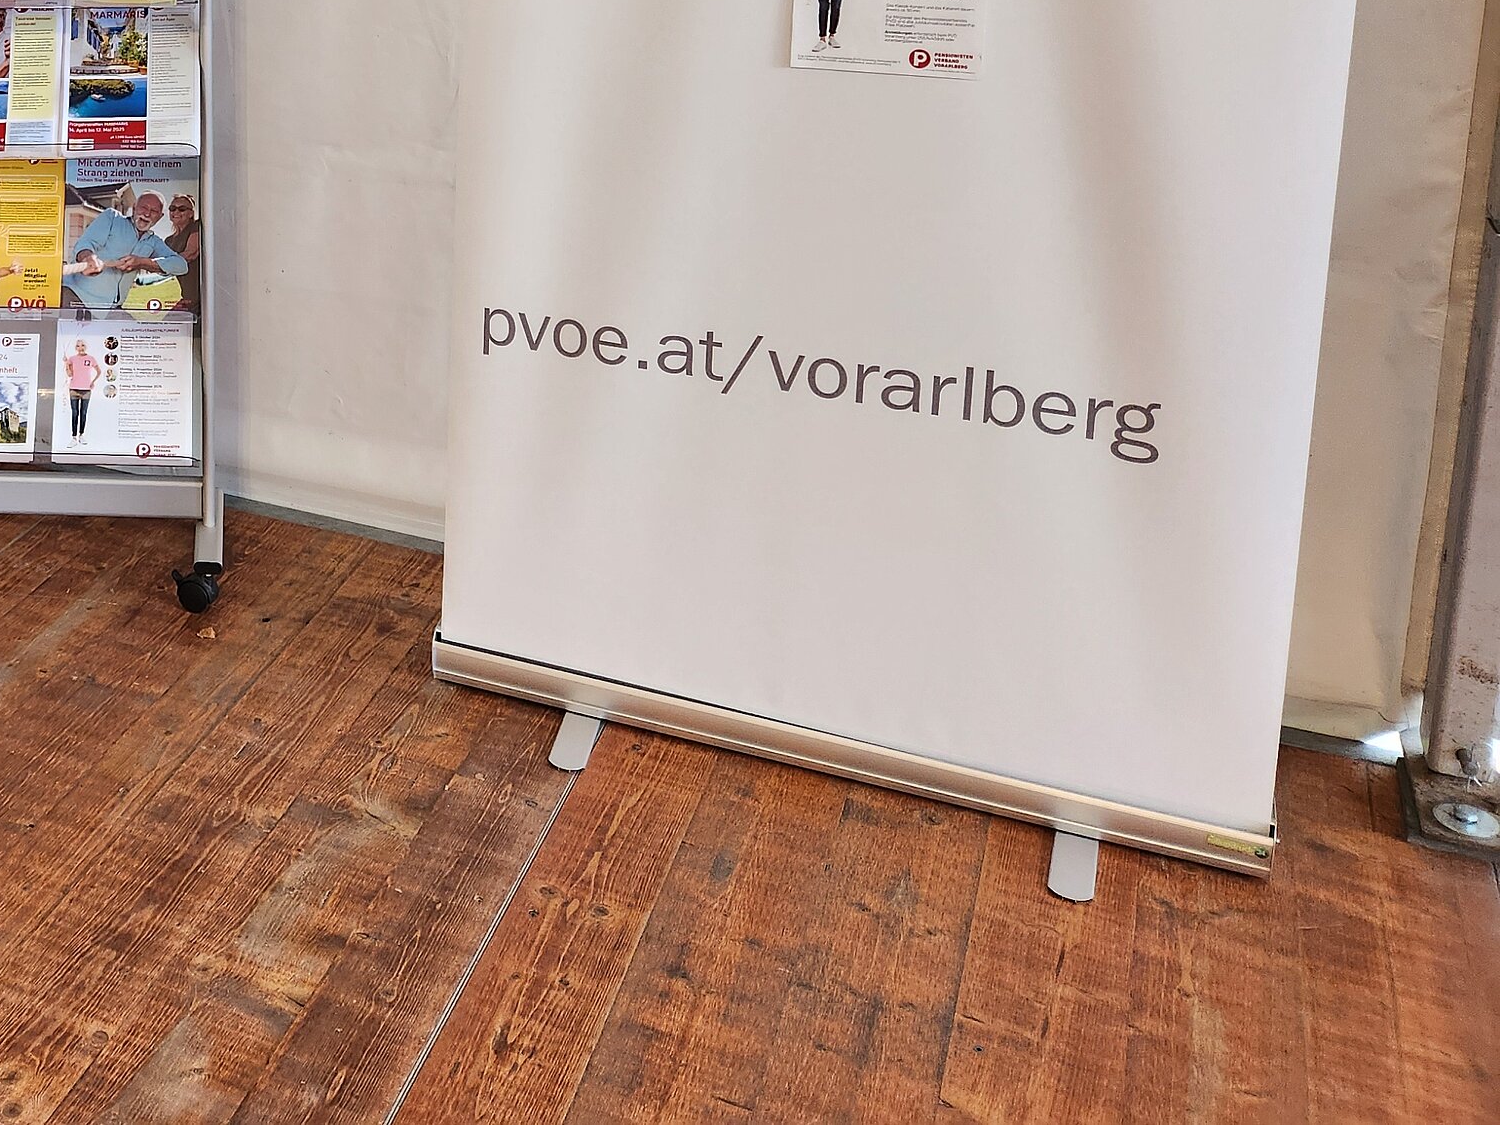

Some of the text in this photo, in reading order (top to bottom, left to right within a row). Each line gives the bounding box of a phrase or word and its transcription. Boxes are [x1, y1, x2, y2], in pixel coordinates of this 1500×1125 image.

[90, 10, 147, 20] MARMARIS
[77, 158, 93, 168] Mit
[94, 159, 115, 168] dem
[139, 160, 151, 168] an
[153, 159, 182, 168] einem
[77, 168, 144, 178] Strang ziehen!
[481, 306, 1162, 466] pvoe.at/vorarlberg
